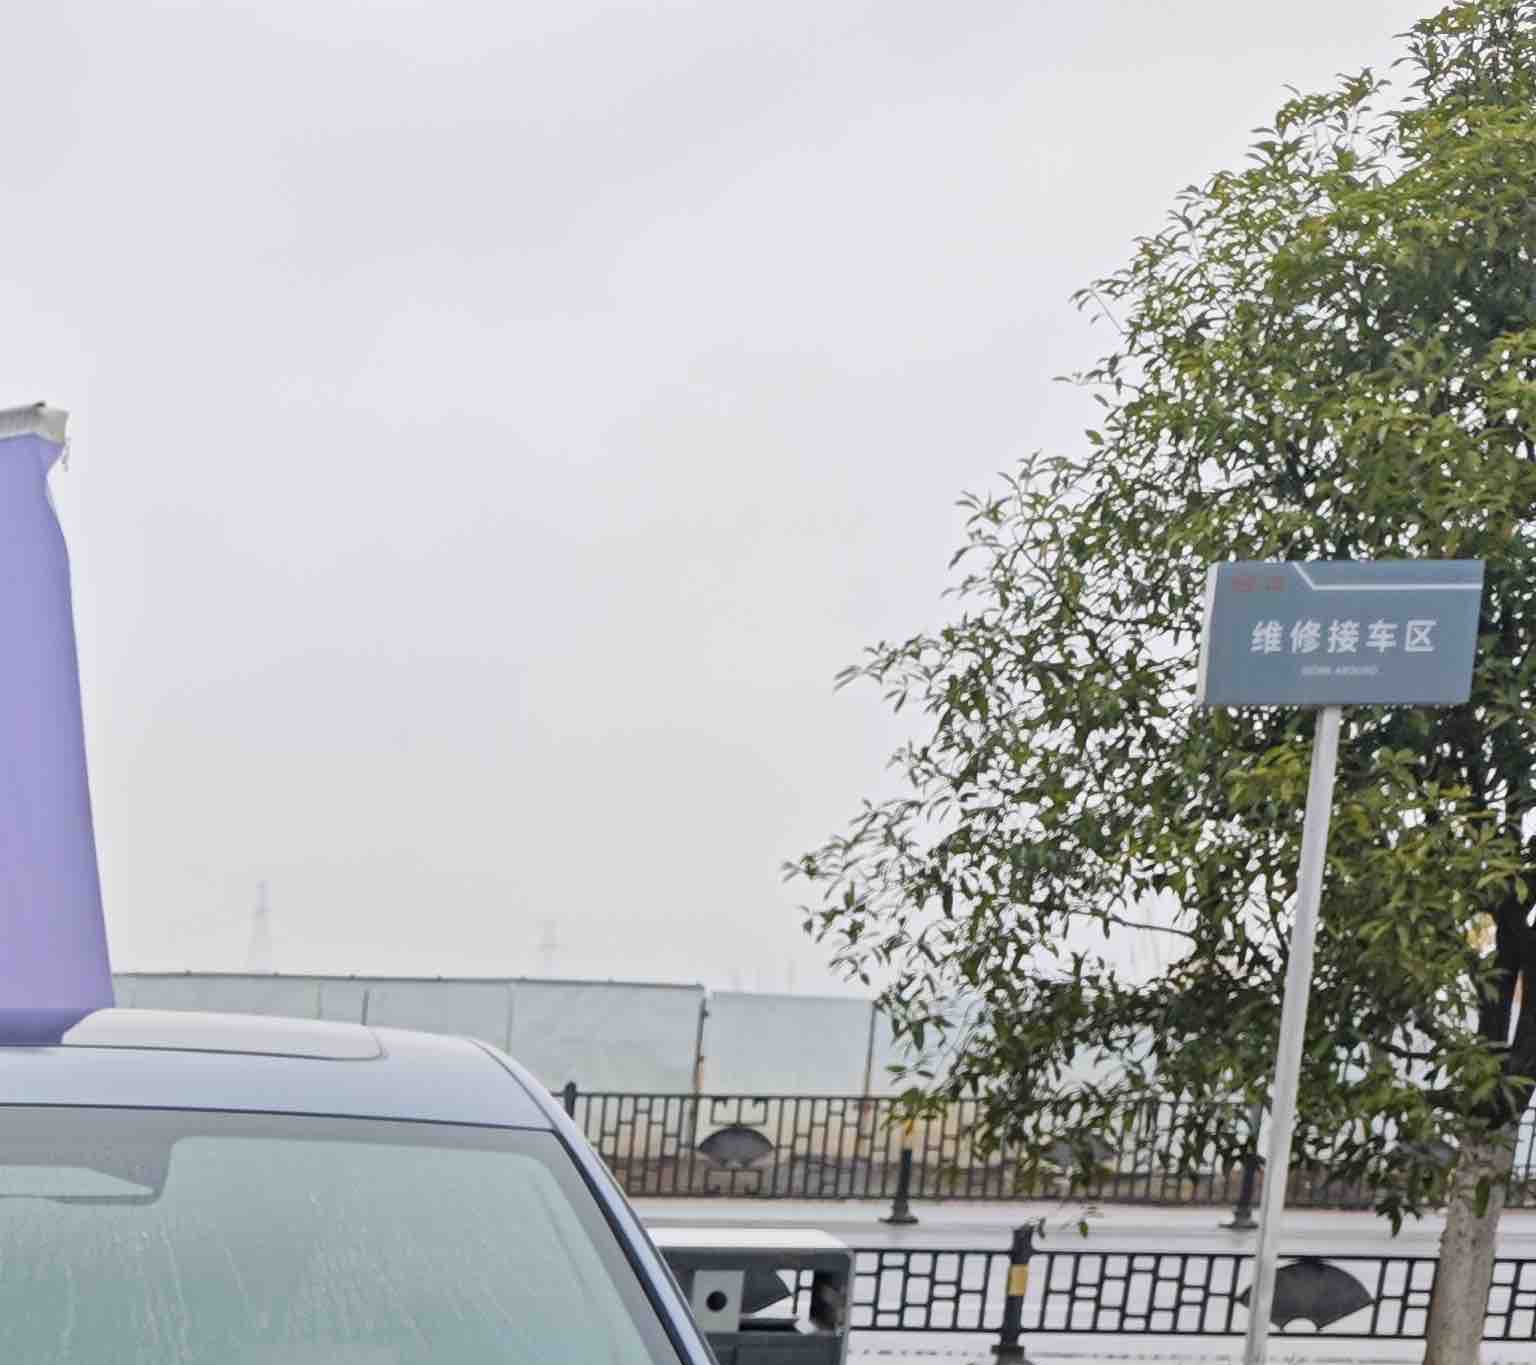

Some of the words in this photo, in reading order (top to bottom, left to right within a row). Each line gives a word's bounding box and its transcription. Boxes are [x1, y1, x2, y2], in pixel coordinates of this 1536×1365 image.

[1249, 618, 1438, 656] 维修接车区
